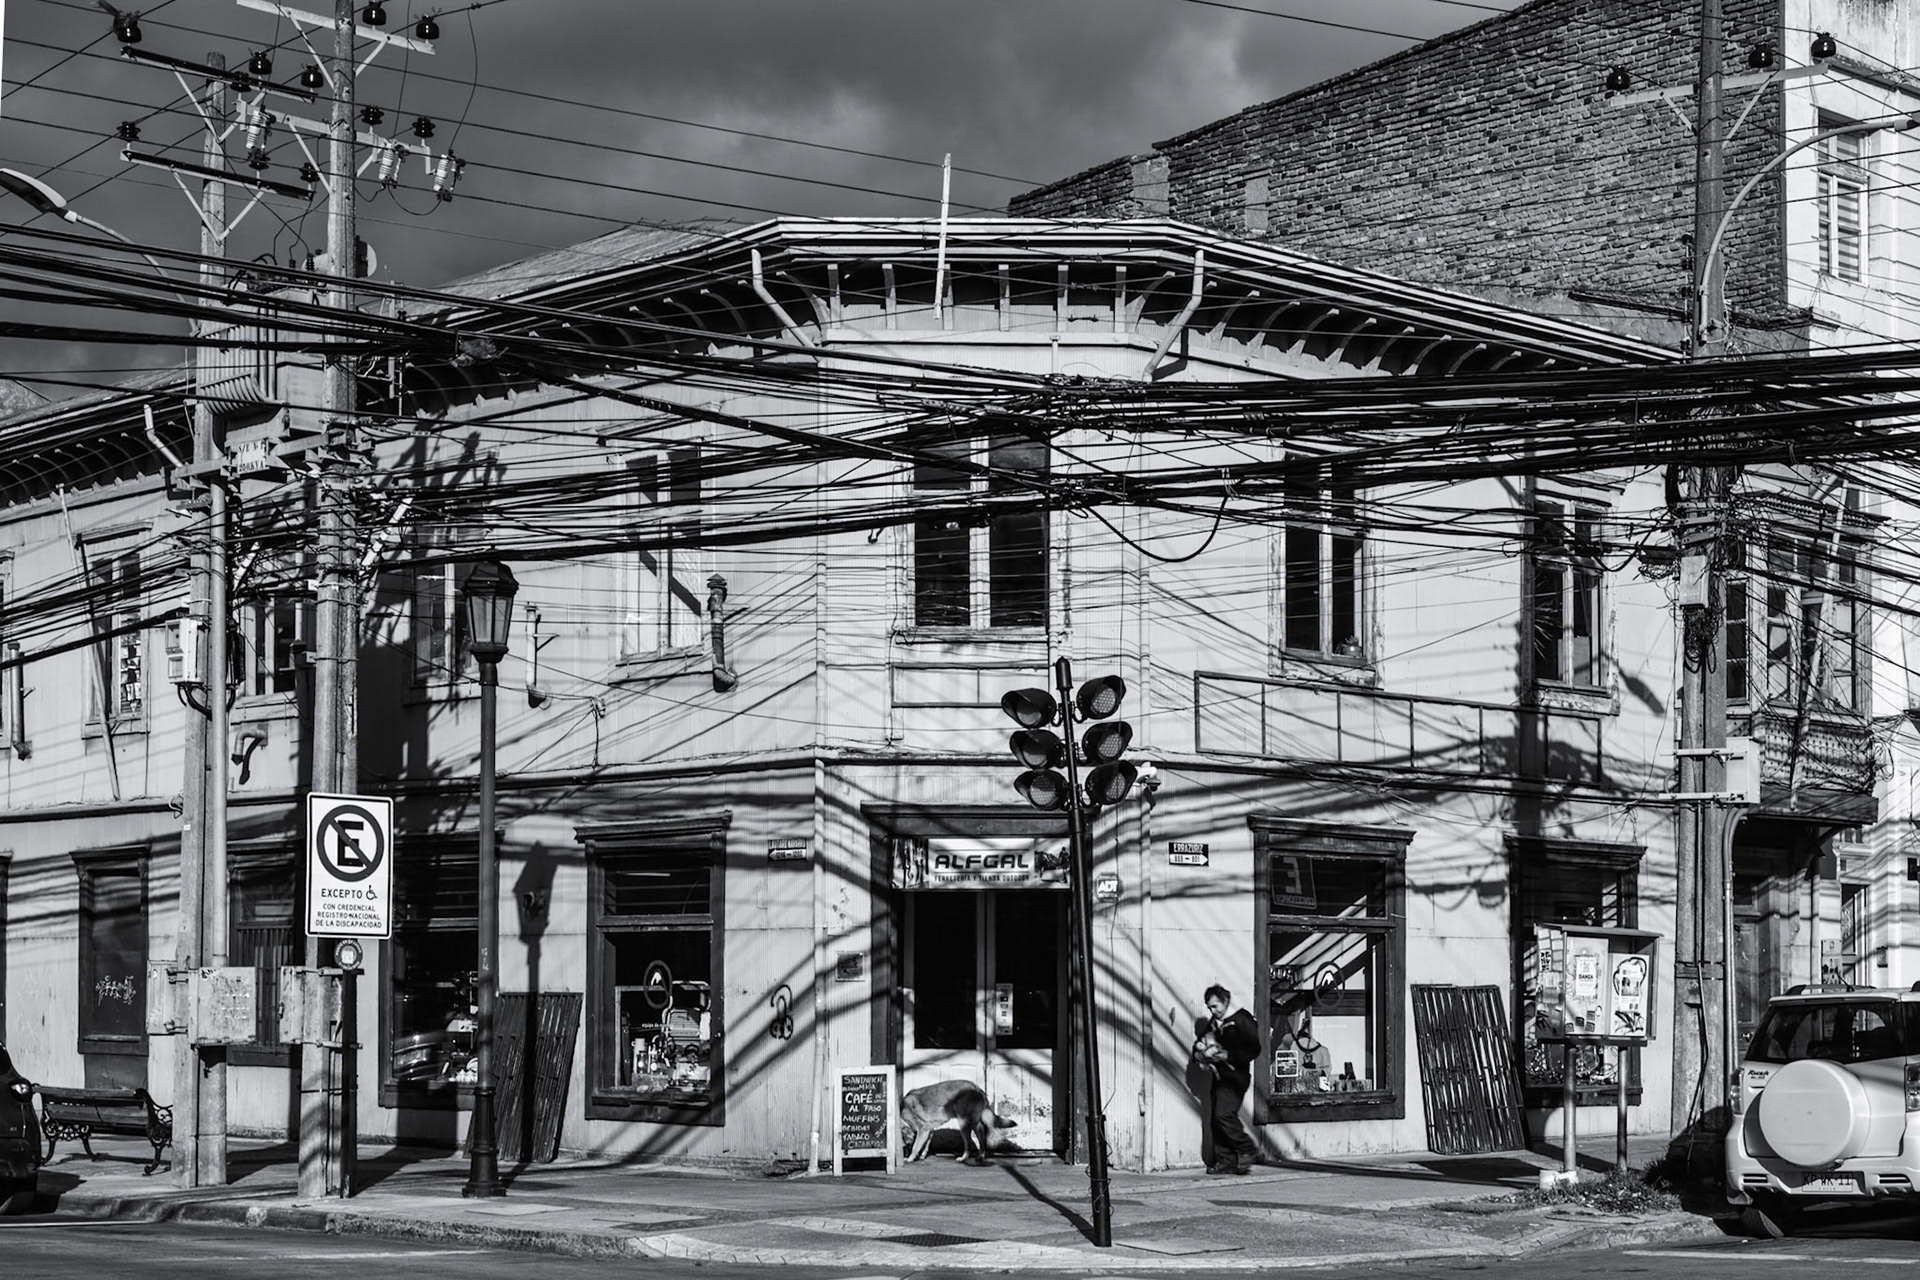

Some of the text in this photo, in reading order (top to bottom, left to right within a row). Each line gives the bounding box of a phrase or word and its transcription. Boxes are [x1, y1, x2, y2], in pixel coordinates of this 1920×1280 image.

[934, 854, 1029, 869] ALFGAL
[979, 874, 1000, 882] TIENDA
[1002, 874, 1030, 882] OUTDOOR
[1098, 880, 1118, 892] ADT
[321, 888, 363, 899] EXCEPTO
[337, 904, 376, 912] CREDENCIAL
[317, 911, 381, 921] REGISTRO NACIONAL
[315, 919, 324, 927] DE
[335, 920, 383, 929] DISCAPACIDAD
[845, 1090, 873, 1104] CAFÉ
